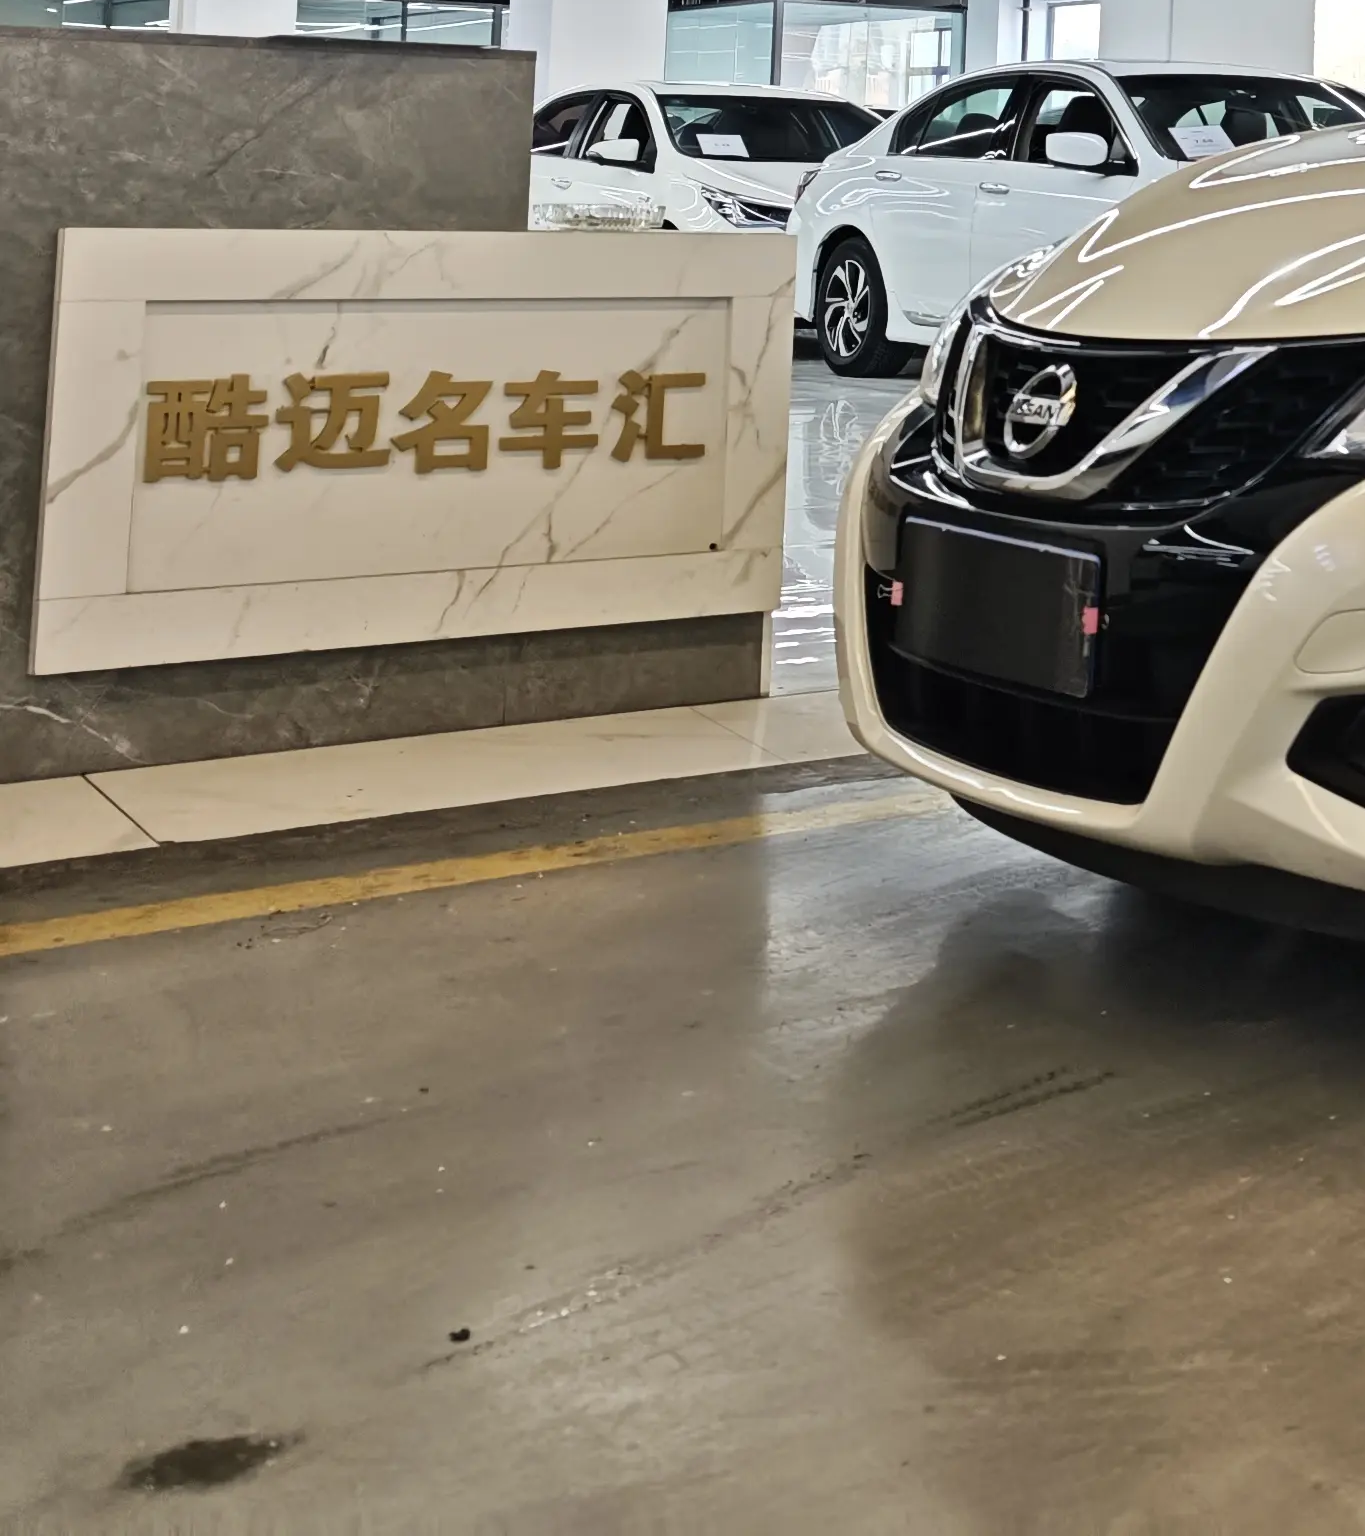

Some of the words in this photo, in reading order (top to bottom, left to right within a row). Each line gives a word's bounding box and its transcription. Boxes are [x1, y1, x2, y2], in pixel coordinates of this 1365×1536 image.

[143, 370, 706, 483] 酷迈名车汇
